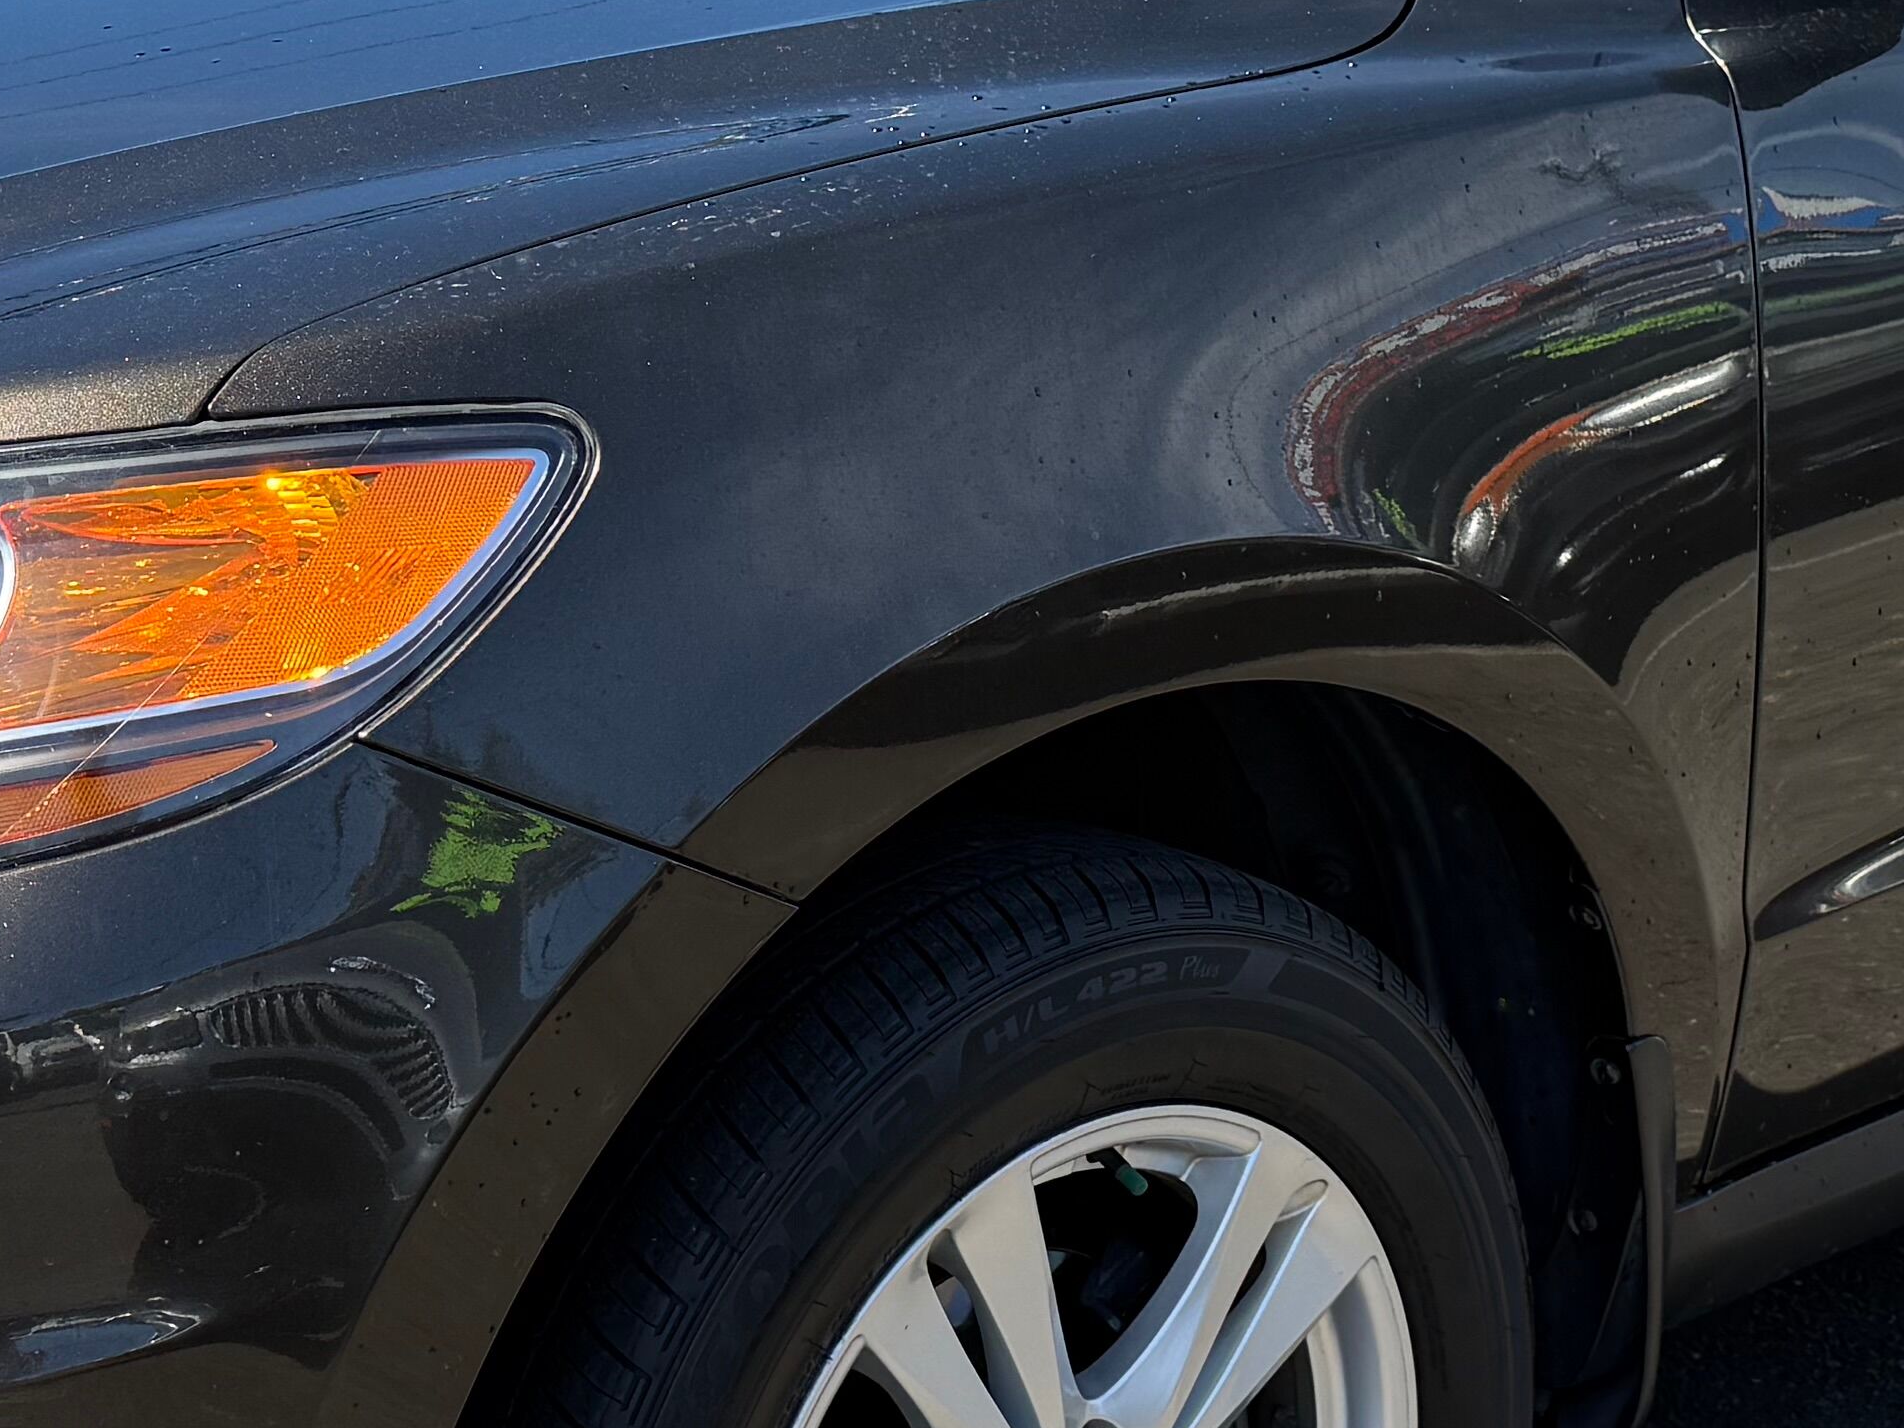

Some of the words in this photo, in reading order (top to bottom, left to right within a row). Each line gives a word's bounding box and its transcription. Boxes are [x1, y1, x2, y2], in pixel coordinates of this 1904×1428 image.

[982, 996, 1070, 1055] H/L
[1076, 960, 1168, 1003] 422
[1178, 954, 1222, 982] Plus
